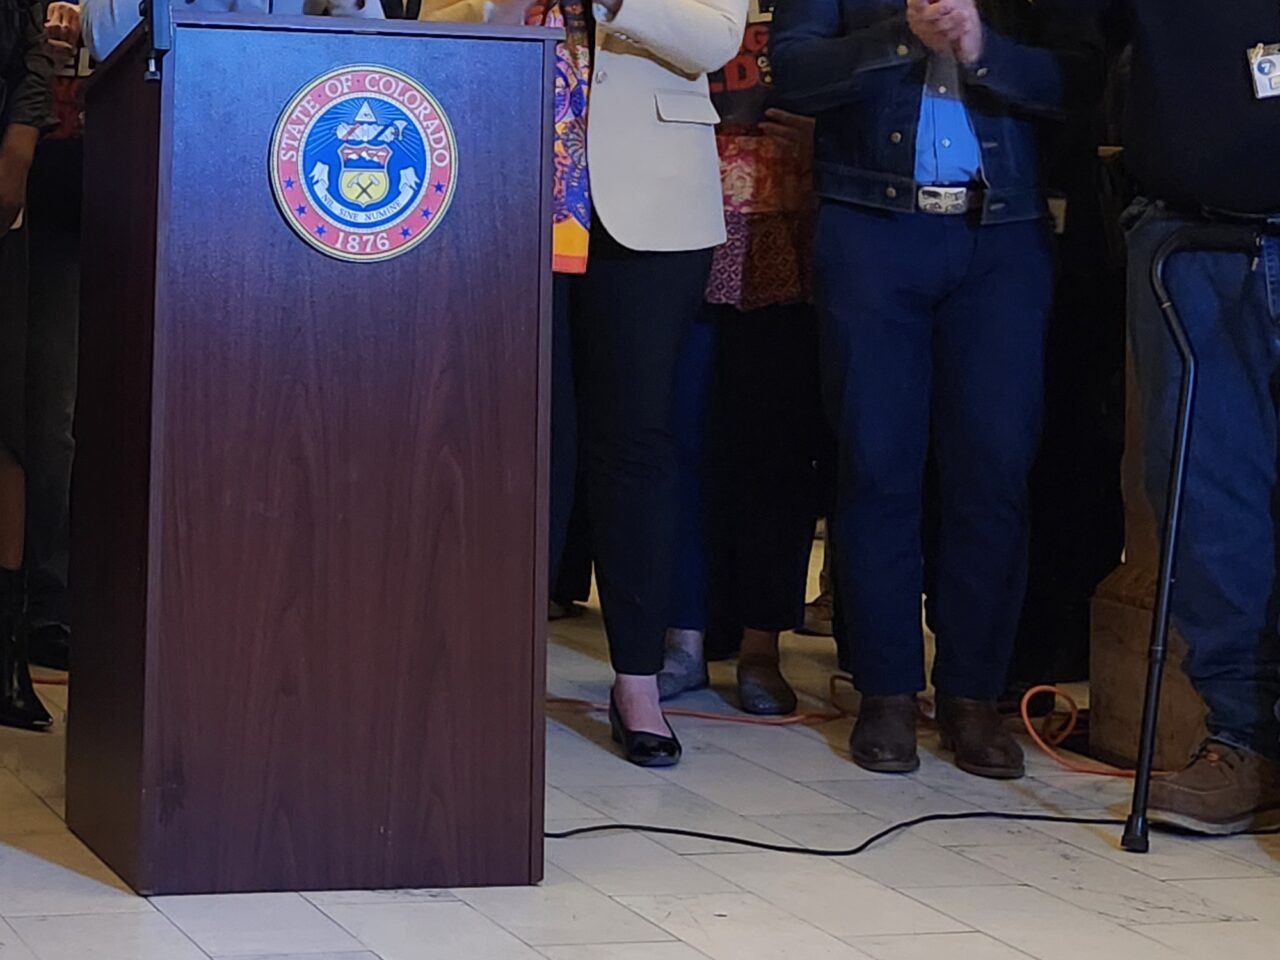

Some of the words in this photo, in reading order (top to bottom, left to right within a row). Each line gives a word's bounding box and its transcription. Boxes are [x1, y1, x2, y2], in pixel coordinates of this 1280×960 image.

[280, 96, 320, 162] STATE
[325, 75, 353, 98] OF
[365, 75, 449, 167] COLORADO
[339, 208, 360, 221] SINE
[364, 200, 401, 221] NUMINE
[335, 231, 389, 253] 1876
